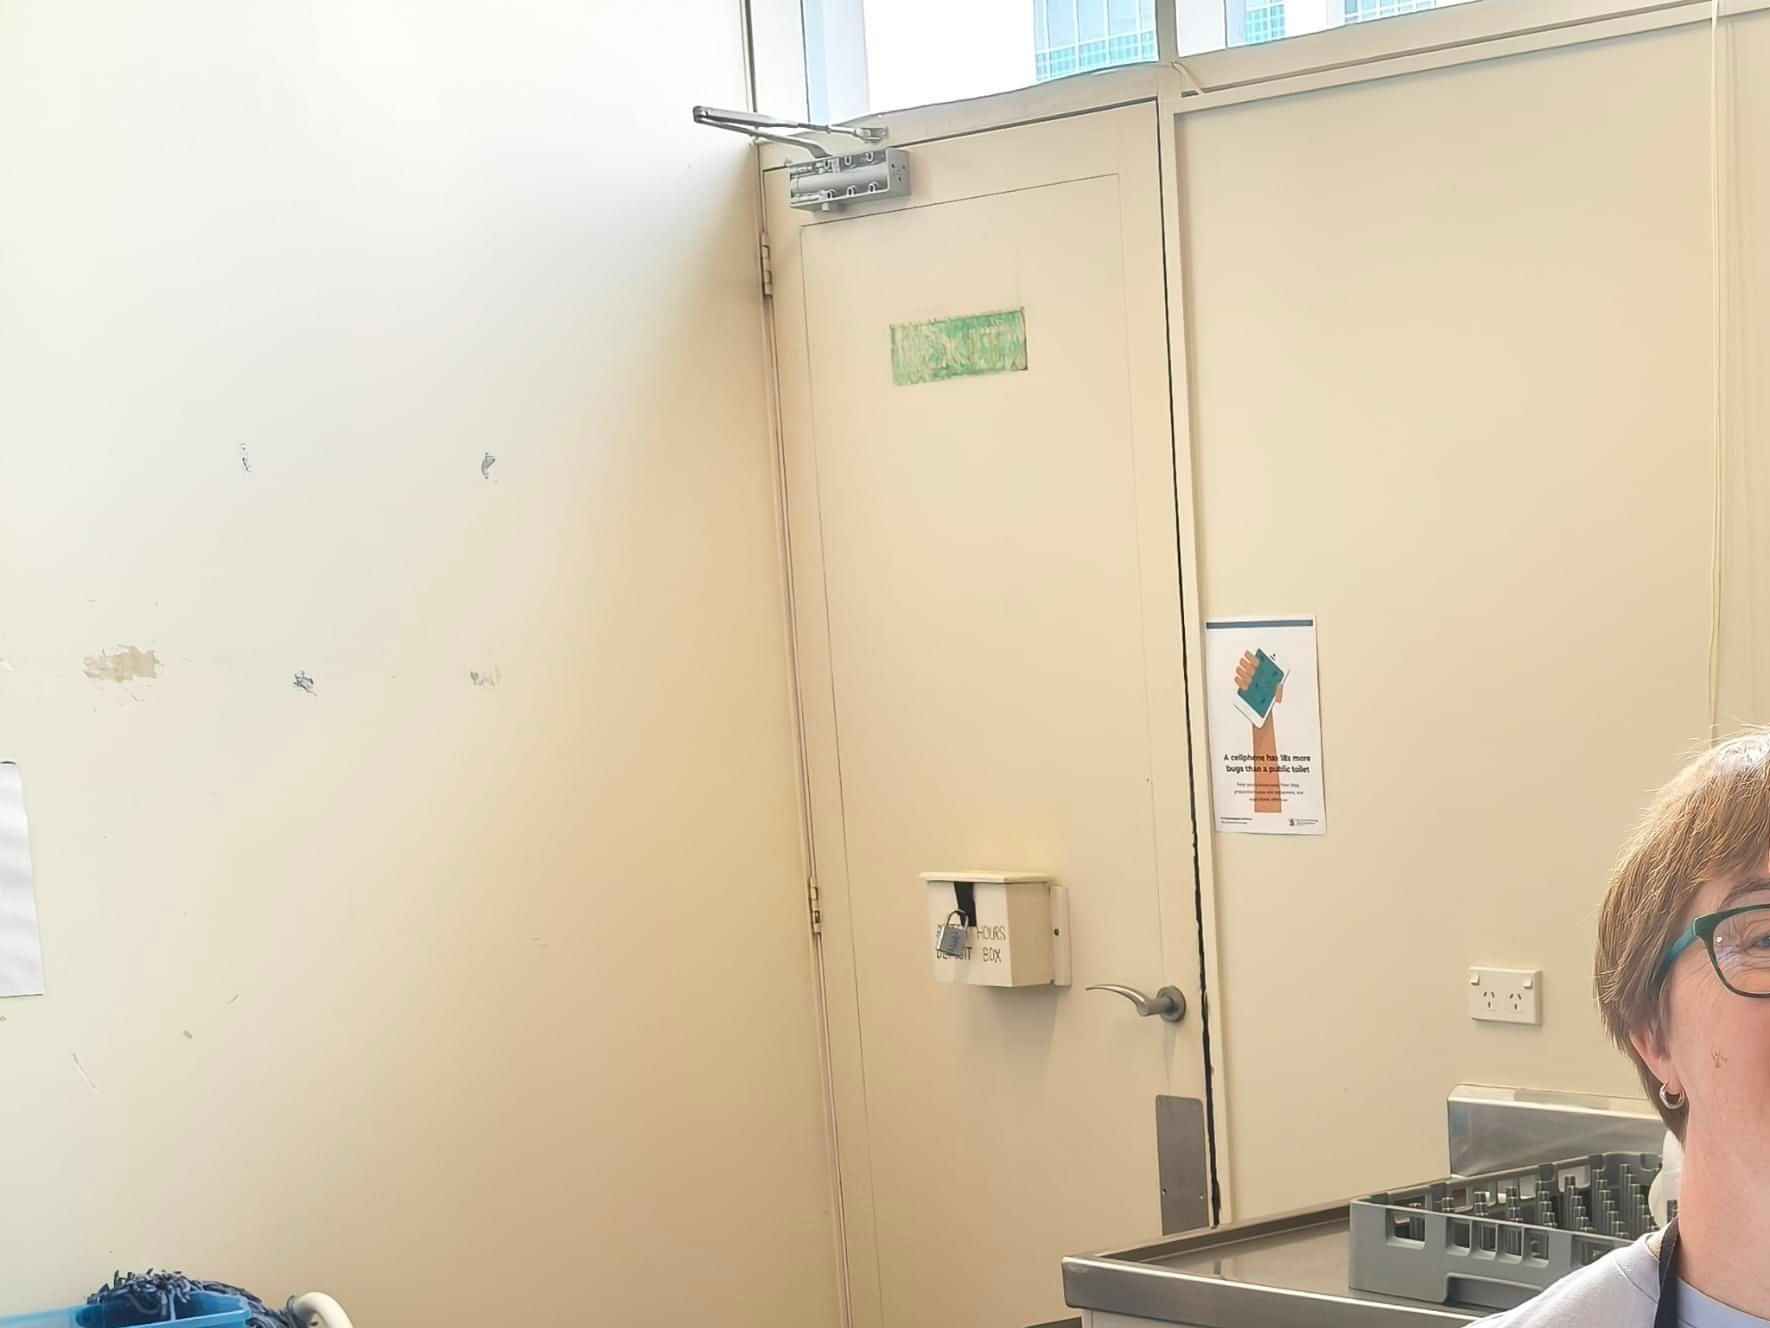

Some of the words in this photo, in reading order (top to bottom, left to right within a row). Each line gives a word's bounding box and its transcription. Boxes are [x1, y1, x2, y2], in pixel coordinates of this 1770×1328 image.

[1226, 765, 1244, 773] bugs
[976, 926, 1006, 940] HOURS
[983, 947, 1002, 963] BOX
